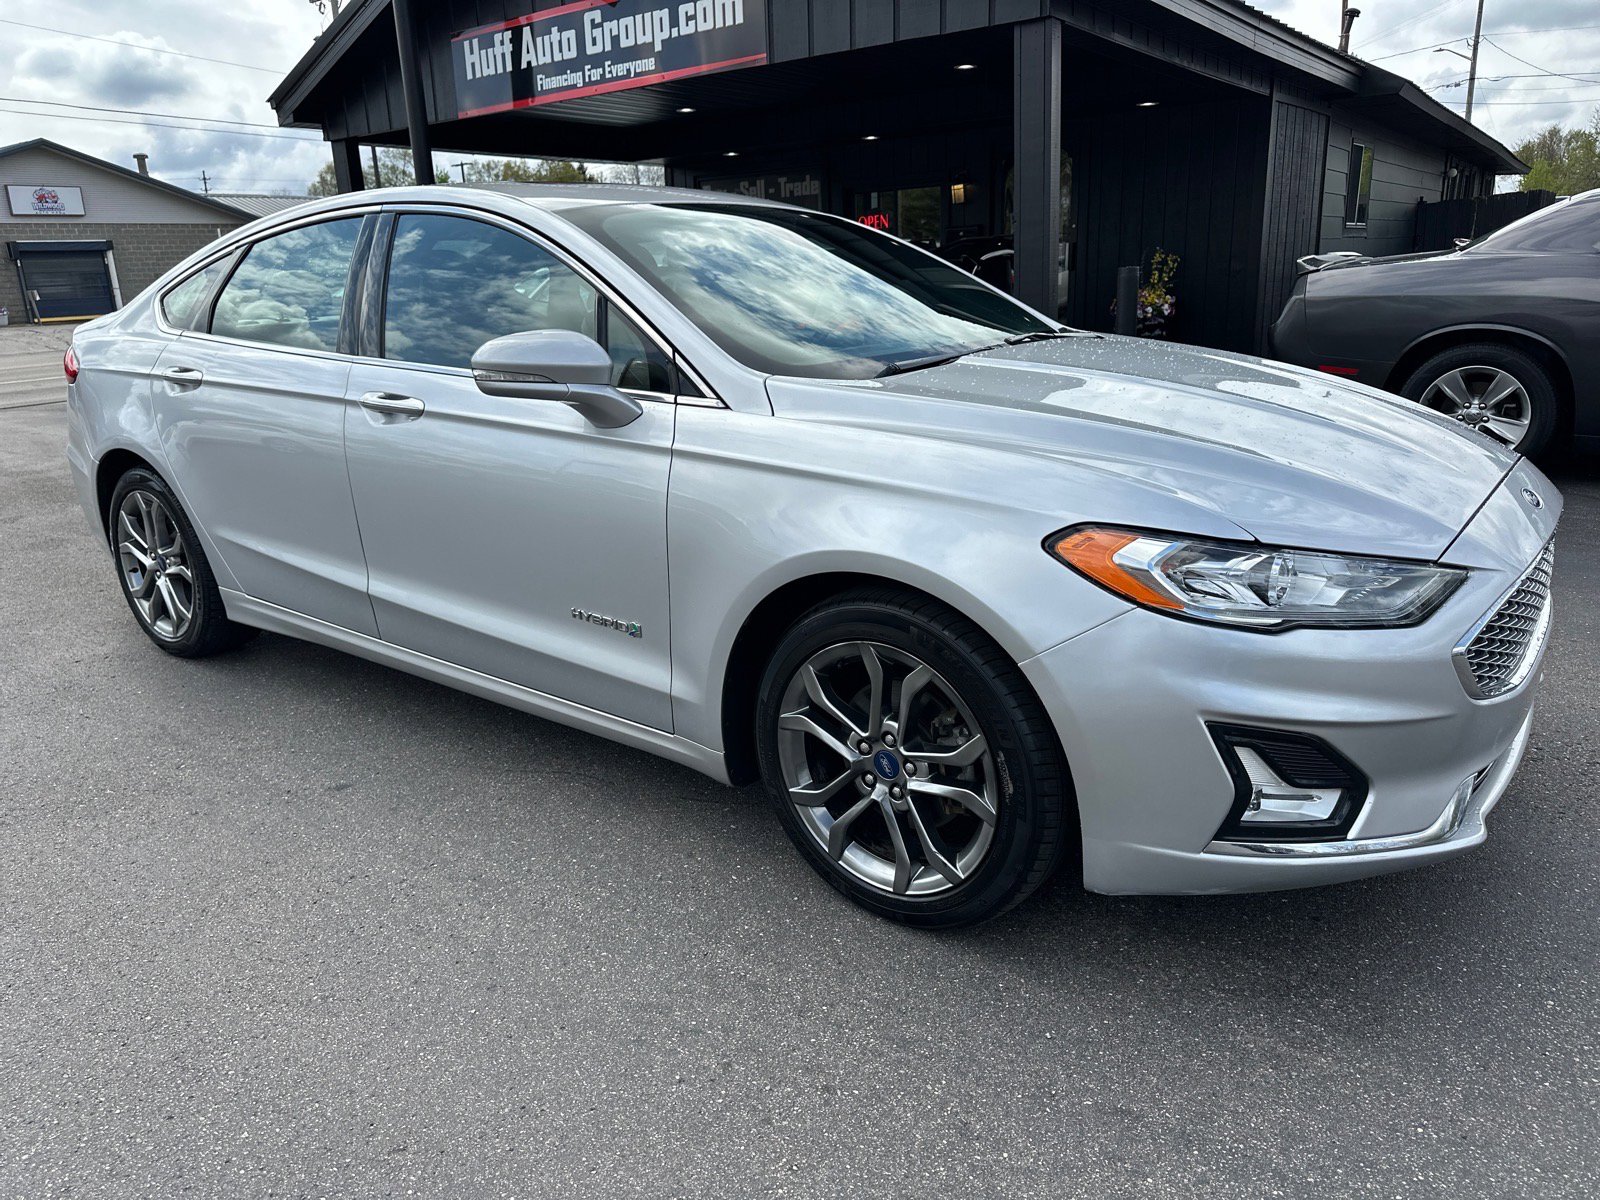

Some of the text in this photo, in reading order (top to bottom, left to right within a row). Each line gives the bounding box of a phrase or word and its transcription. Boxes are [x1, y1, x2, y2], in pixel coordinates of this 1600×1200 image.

[464, 0, 744, 80] Huff Auto Group.com
[537, 57, 656, 91] Financing For Everyone
[778, 174, 820, 198] Trade
[858, 212, 890, 230] OPEN
[571, 607, 629, 632] HYBRID
